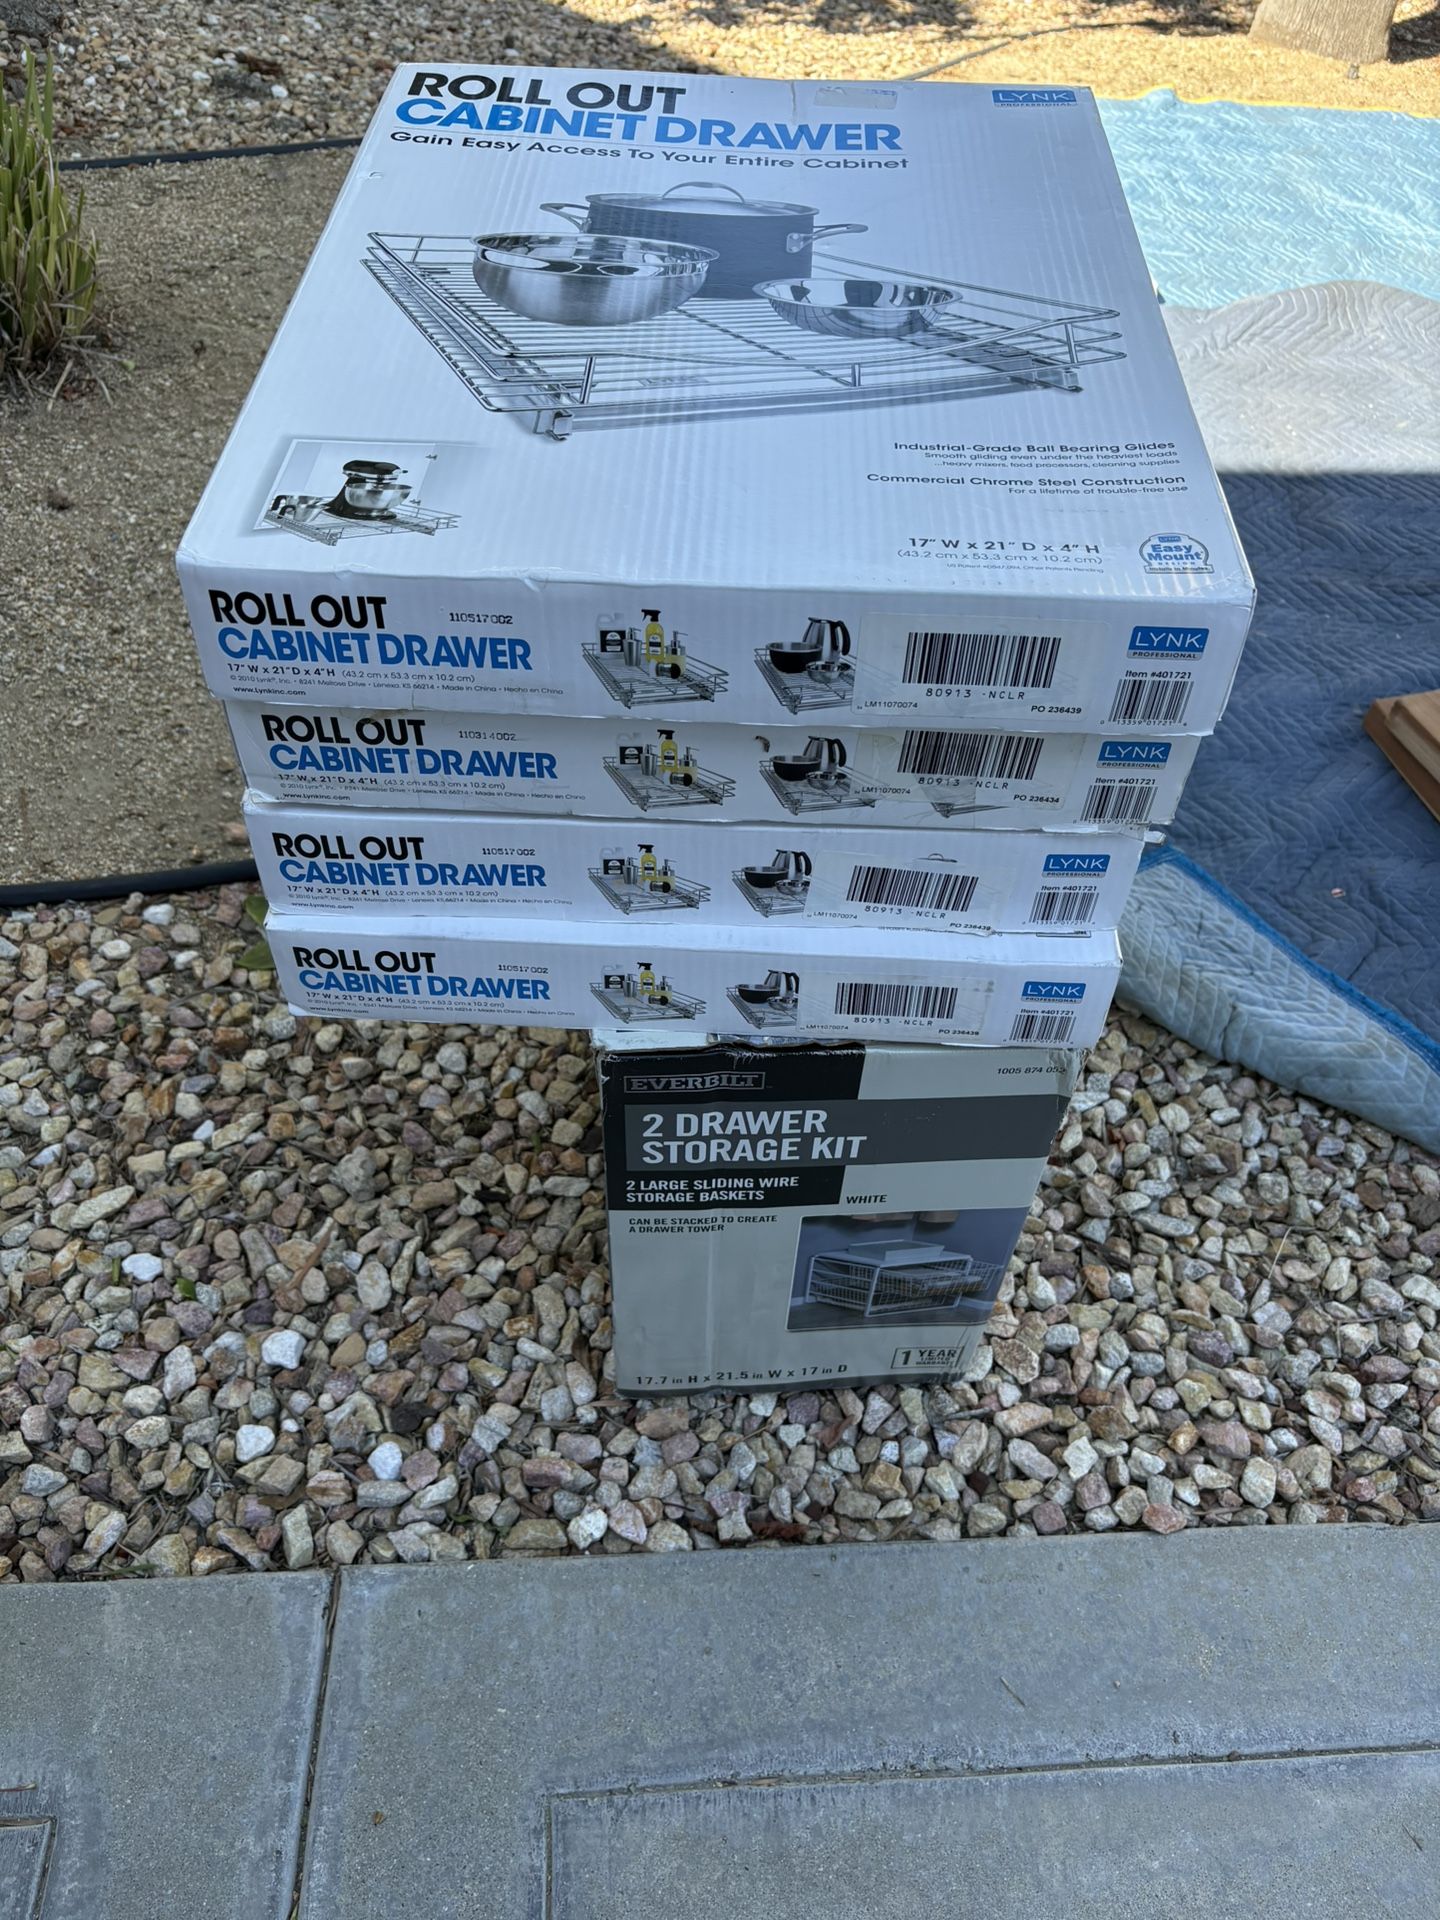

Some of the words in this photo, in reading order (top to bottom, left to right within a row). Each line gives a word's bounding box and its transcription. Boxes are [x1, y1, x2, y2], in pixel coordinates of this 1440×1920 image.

[408, 71, 551, 105] ROLL
[566, 82, 686, 114] OUT
[999, 92, 1070, 101] LYNK
[396, 98, 647, 140] CABINET
[655, 116, 902, 150] DRAWER
[390, 131, 451, 146] Gain
[462, 137, 521, 152] Easy
[527, 142, 621, 158] Access
[628, 148, 654, 161] To
[662, 151, 717, 164] Your
[725, 155, 794, 168] Entire
[803, 158, 909, 169] Cabinet
[894, 442, 1022, 452] Industrial-Grade
[1059, 444, 1120, 454] Bearing
[1124, 442, 1175, 451] Glides
[970, 453, 1008, 461] gliding
[867, 473, 965, 484] Commercial
[970, 477, 1033, 486] Chrome
[1038, 478, 1077, 486] Steel
[1081, 476, 1185, 486] Construction
[942, 539, 960, 549] W
[1022, 543, 1036, 551] D
[1085, 545, 1100, 554] H
[1151, 544, 1192, 553] Easy
[1147, 552, 1202, 560] Mount
[208, 589, 306, 626] ROLL
[310, 594, 387, 629] OUT
[1135, 631, 1202, 648] LYNK
[218, 627, 371, 664] CABINET
[377, 633, 533, 671] DRAWER
[1132, 651, 1198, 659] PROFESSIONAL
[248, 665, 259, 673] W
[292, 667, 300, 675] D
[327, 668, 335, 677] H
[342, 670, 364, 678] (43.2
[391, 671, 410, 680] 53.3
[412, 673, 427, 681] cm
[436, 673, 454, 682] 10.2
[456, 673, 475, 683] cm)
[1125, 670, 1148, 678] Item
[1150, 671, 1192, 679] #401721
[925, 688, 972, 698] 80913
[981, 690, 1026, 700] -NCLR
[864, 700, 918, 709] LM11070074
[1030, 705, 1046, 713] PO
[1047, 706, 1082, 715] 236439
[261, 714, 350, 743] ROLL
[355, 718, 425, 746] OUT
[1104, 745, 1165, 760] LYNK
[270, 744, 410, 774] CABINET
[416, 748, 558, 779] DRAWER
[918, 777, 960, 787] 80913
[970, 780, 1009, 790] -NCLR
[272, 832, 354, 860] ROLL
[359, 836, 424, 860] OUT
[1048, 858, 1105, 869] LYNK
[279, 859, 410, 886] CABINET
[415, 863, 547, 887] DRAWER
[864, 905, 903, 914] 80913
[292, 946, 370, 972] ROLL
[374, 951, 436, 973] OUT
[299, 970, 421, 995] CABINET
[426, 975, 551, 1000] DRAWER
[1027, 984, 1080, 996] LYNK
[630, 1073, 761, 1091] EVERBILT
[642, 1113, 664, 1138] 2
[676, 1110, 828, 1137] DRAWER
[642, 1137, 802, 1165] STORAGE
[811, 1136, 868, 1161] KIT
[626, 1181, 636, 1191] 2
[640, 1180, 689, 1191] LARGE
[693, 1178, 754, 1190] SLIDING
[759, 1176, 800, 1188] WIRE
[626, 1192, 695, 1203] STORAGE
[700, 1190, 765, 1202] BASKETS
[846, 1194, 887, 1204] WHITE
[629, 1218, 650, 1226] CAN
[653, 1217, 668, 1225] BE
[670, 1216, 718, 1225] STACKED
[720, 1216, 734, 1224] TO
[737, 1215, 777, 1223] CREATE
[628, 1225, 636, 1233] A
[638, 1225, 684, 1233] DRAWER
[686, 1224, 725, 1233] TOWER
[902, 1350, 911, 1365] 1
[918, 1349, 957, 1357] YEAR
[636, 1376, 667, 1385] 17.7
[688, 1375, 698, 1383] H
[716, 1371, 748, 1380] 21.5
[768, 1369, 782, 1378] W
[801, 1366, 818, 1376] 17
[837, 1364, 848, 1373] D
